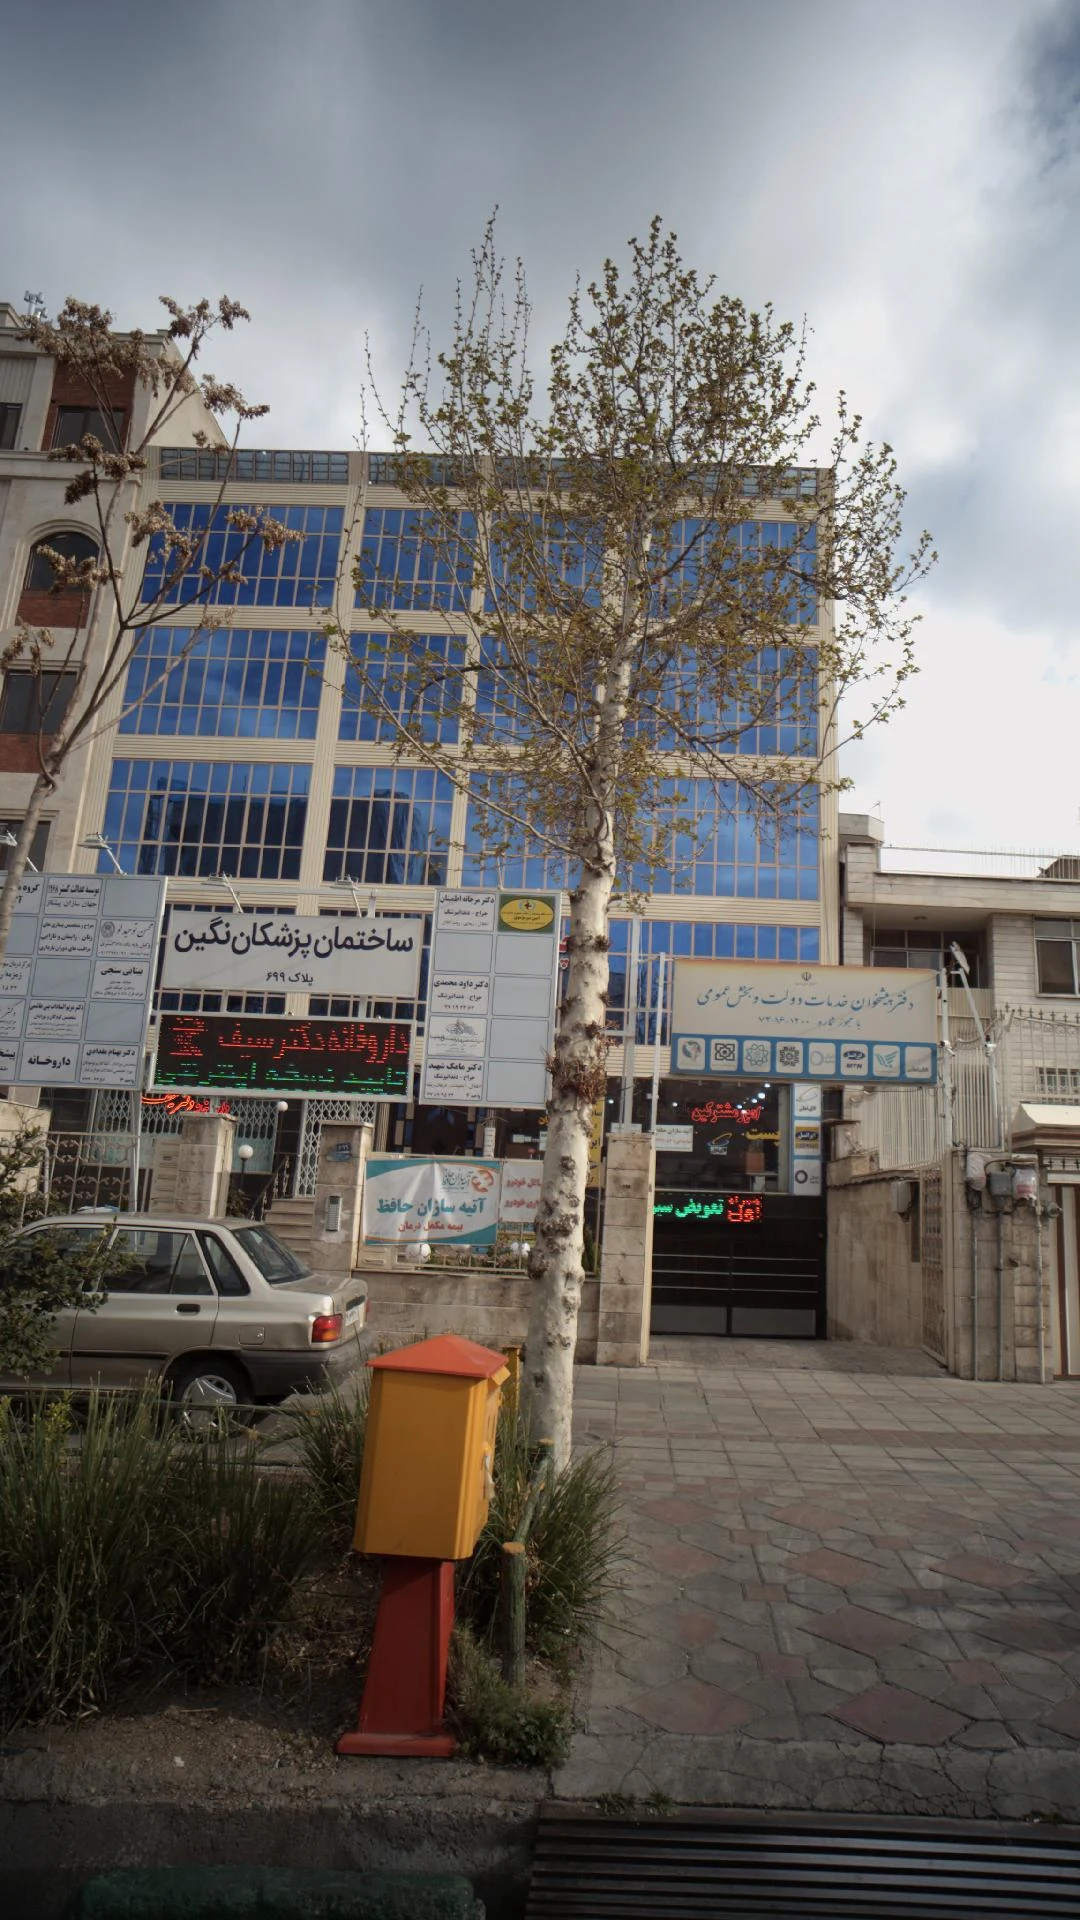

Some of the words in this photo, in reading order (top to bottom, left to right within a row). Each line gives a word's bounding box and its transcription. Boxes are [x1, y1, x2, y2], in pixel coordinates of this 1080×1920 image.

[481, 896, 495, 905] دکتر
[173, 916, 231, 953] نگین
[231, 922, 313, 958] پزشکان
[313, 924, 414, 958] ساختمان
[100, 967, 121, 976] سنجی
[266, 972, 286, 983] ۶۹۹
[288, 971, 314, 986] پلاک
[459, 980, 474, 990] داود
[474, 981, 489, 990] دکتر
[697, 985, 730, 1006] عمومی
[727, 985, 755, 1008] بخش
[752, 995, 760, 1004] و
[761, 989, 803, 1006] دولت
[804, 994, 849, 1008] خدمات
[851, 987, 894, 1011] پیشخوان
[888, 991, 914, 1013] دفتر
[272, 1022, 325, 1059] دکتر
[328, 1023, 410, 1064] داروخانه
[27, 1055, 71, 1068] داروخانه
[121, 1049, 136, 1058] دکتر
[466, 1063, 482, 1072] دکتر
[691, 1101, 739, 1123] مشترکین
[736, 1104, 762, 1124] امور
[745, 1128, 782, 1147] پست
[505, 1177, 526, 1188] خودرو
[376, 1197, 414, 1214] حافظ
[416, 1197, 455, 1217] سازان
[458, 1197, 487, 1217] آتیه
[504, 1198, 524, 1208] خودرو
[675, 1199, 724, 1219] تعویض
[399, 1221, 421, 1232] درمان
[423, 1221, 445, 1232] مکمل
[447, 1223, 464, 1232] بیمه
